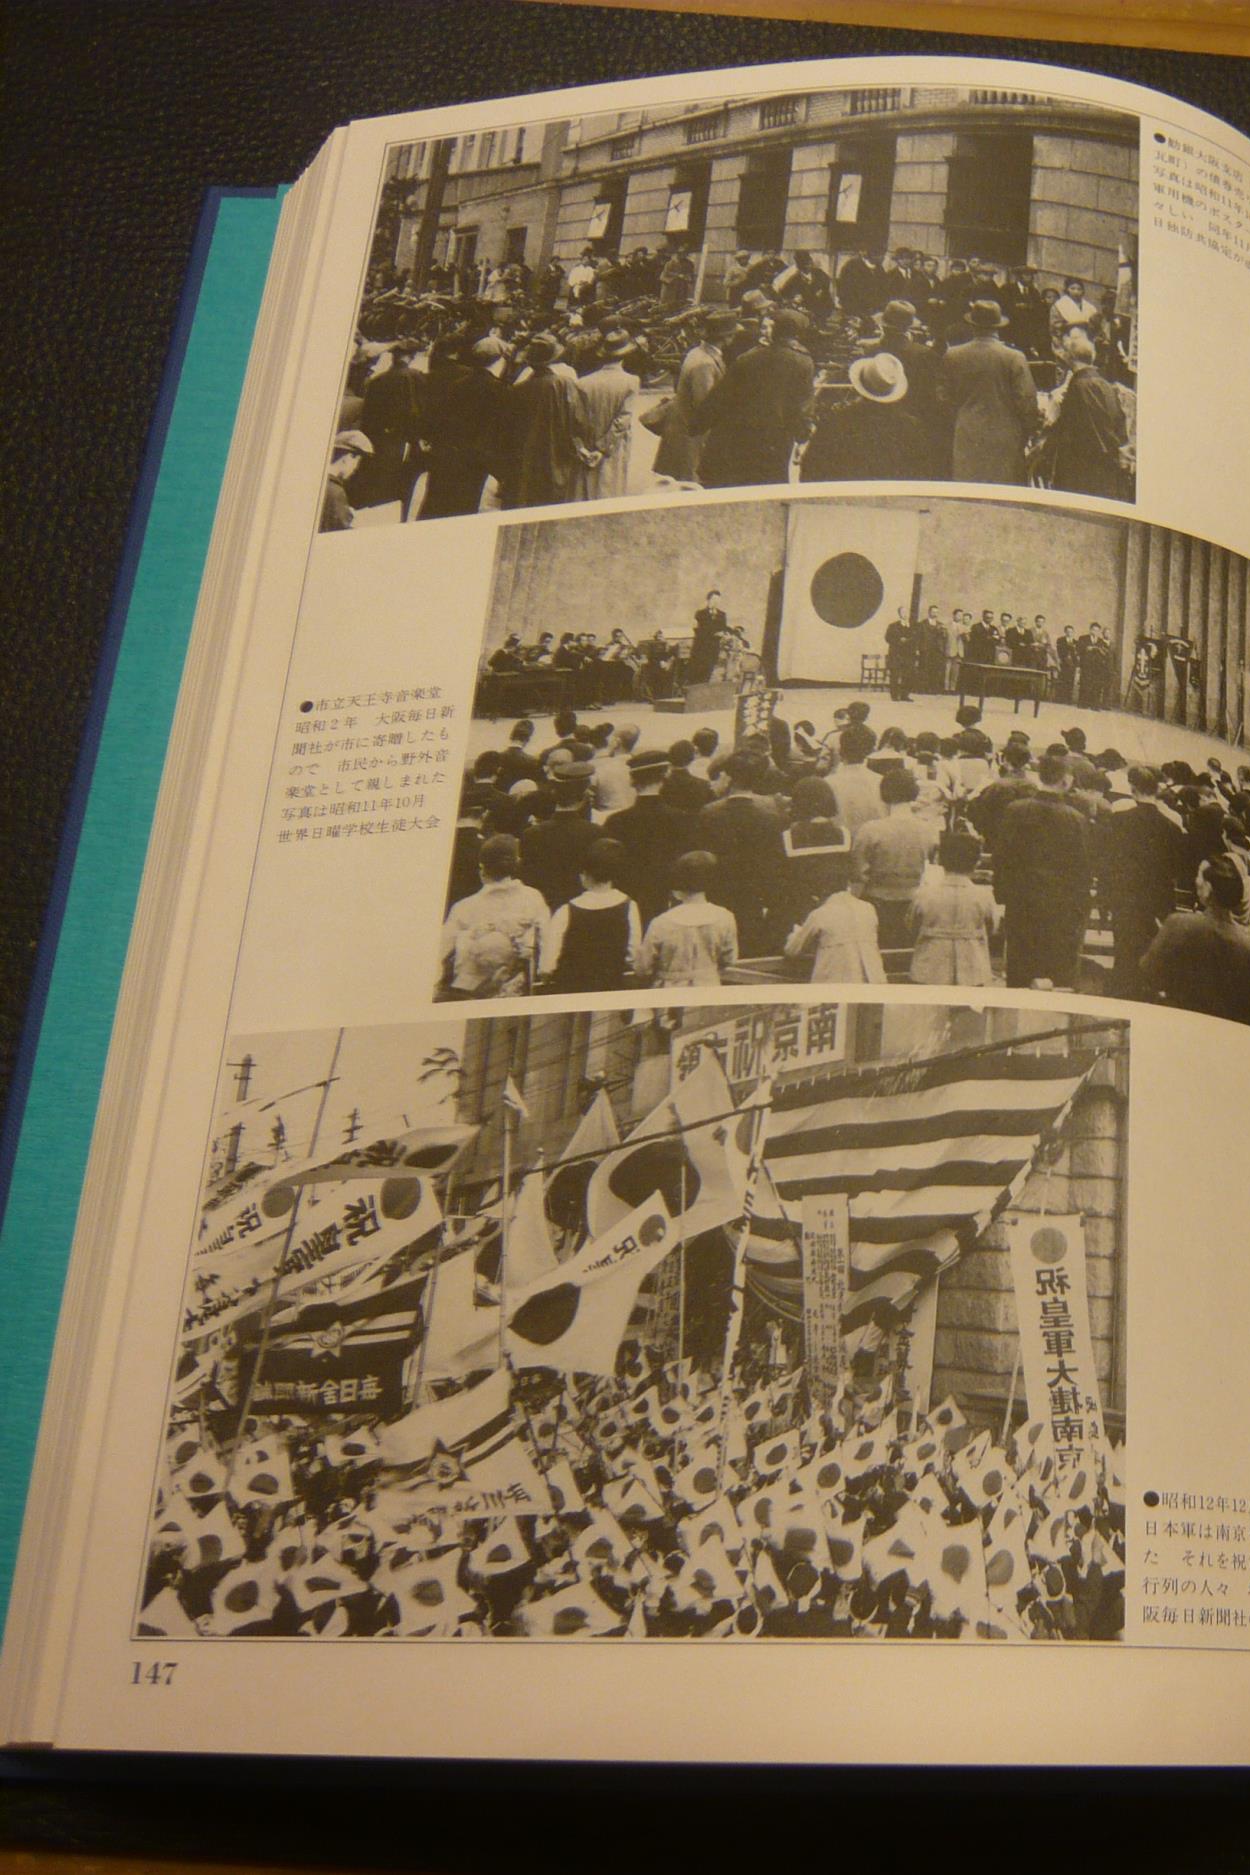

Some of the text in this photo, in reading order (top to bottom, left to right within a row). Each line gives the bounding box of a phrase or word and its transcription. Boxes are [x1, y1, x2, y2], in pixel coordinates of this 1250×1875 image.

[316, 686, 442, 712] 市立天王寺音楽堂
[375, 705, 455, 726] 大阪毎日新
[337, 749, 449, 772] 市民から野外音
[285, 772, 446, 799] 楽堂として親しまれた
[281, 794, 425, 820] 写真は昭和11年10月
[277, 815, 441, 844] 世界日曜学校生徒大会
[1143, 1577, 1229, 1597] 行列の人々
[131, 1661, 179, 1686] 147
